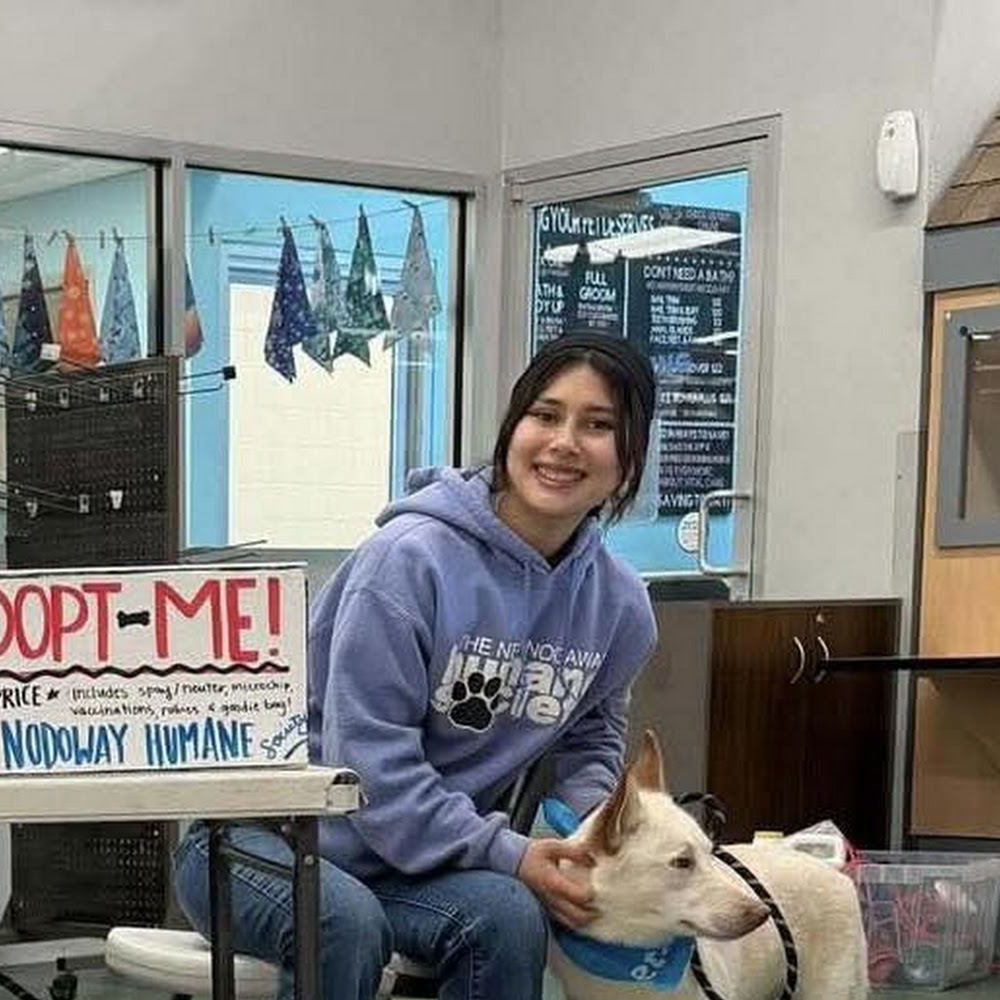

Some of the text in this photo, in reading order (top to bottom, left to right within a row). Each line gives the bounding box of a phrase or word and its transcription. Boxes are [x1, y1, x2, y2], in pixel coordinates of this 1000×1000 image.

[585, 270, 608, 287] FULL
[579, 286, 617, 302] GROOM
[154, 577, 281, 663] ME!
[72, 685, 129, 700] includes
[221, 701, 260, 718] goodie
[0, 719, 129, 770] NODOWAY
[144, 717, 254, 768] HUMANE
